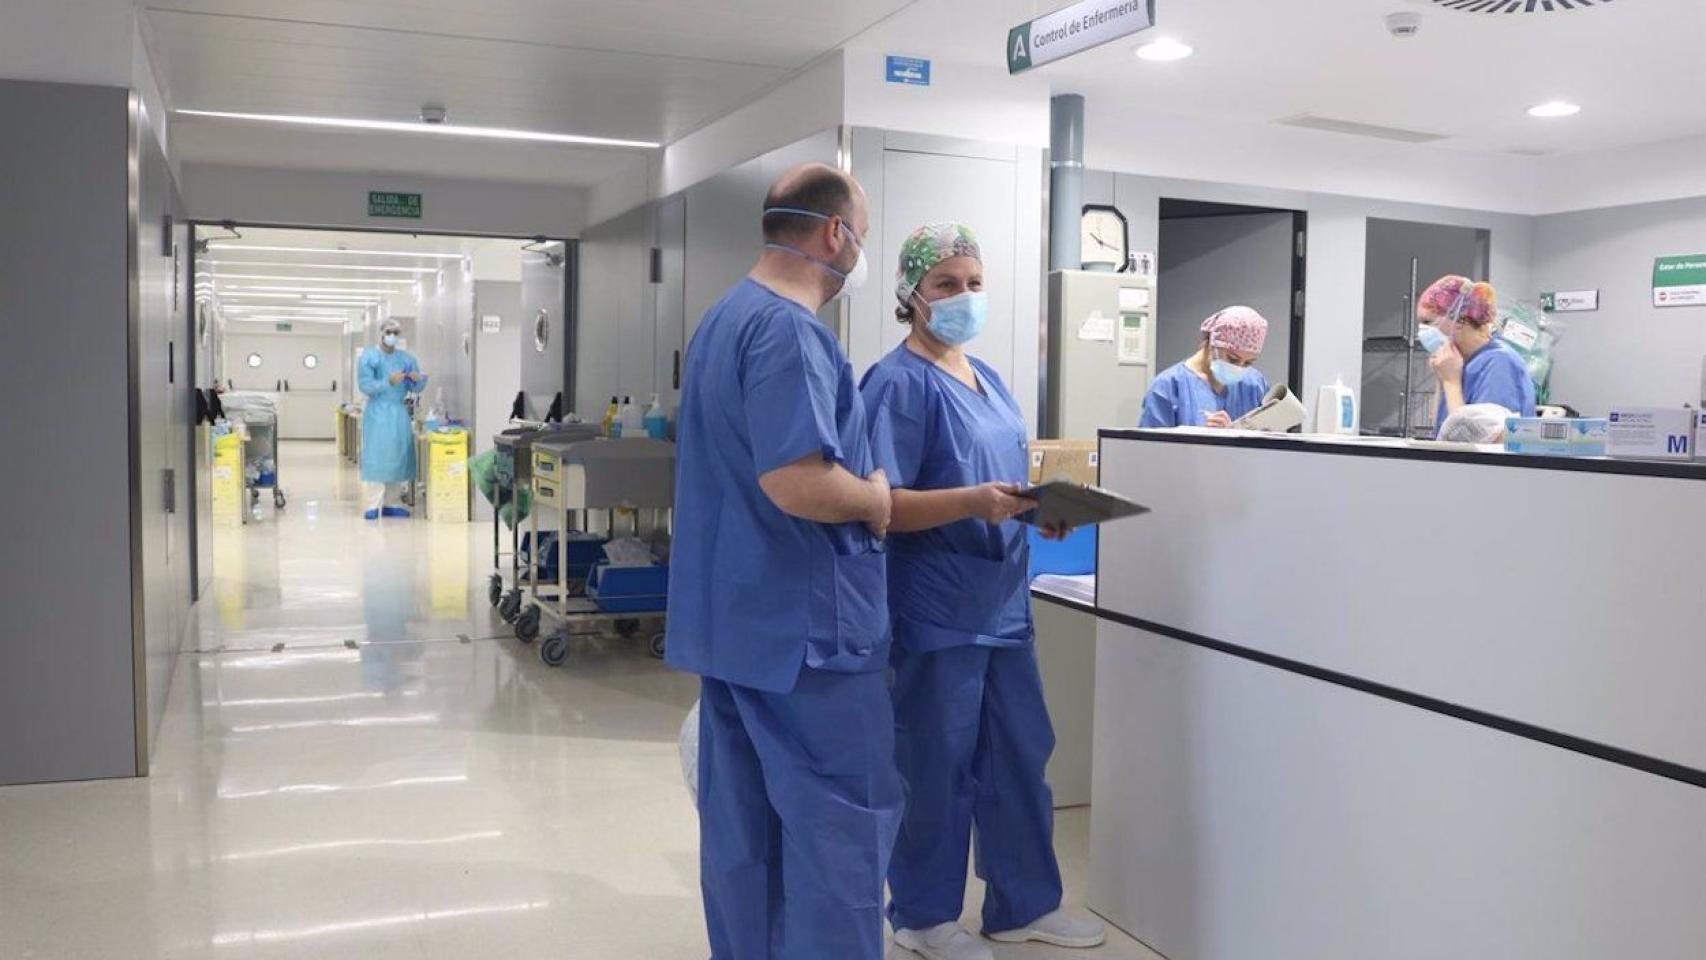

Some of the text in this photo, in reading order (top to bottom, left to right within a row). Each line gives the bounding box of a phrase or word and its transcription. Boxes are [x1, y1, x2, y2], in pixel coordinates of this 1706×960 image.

[1033, 23, 1068, 48] Control
[1070, 20, 1081, 35] de
[1667, 434, 1688, 454] M
